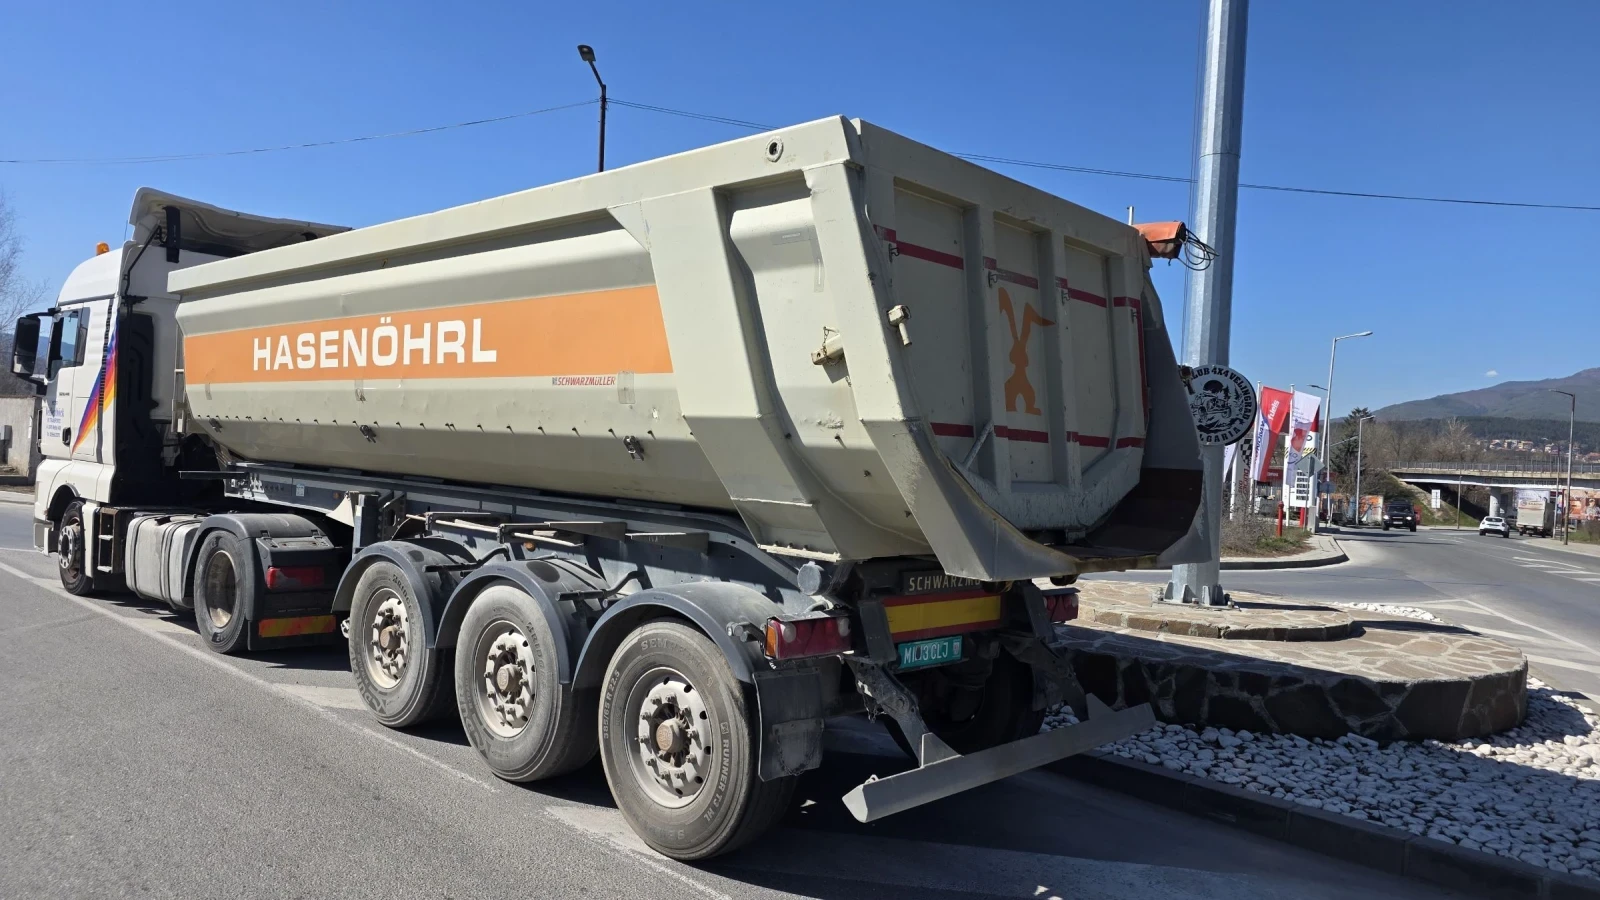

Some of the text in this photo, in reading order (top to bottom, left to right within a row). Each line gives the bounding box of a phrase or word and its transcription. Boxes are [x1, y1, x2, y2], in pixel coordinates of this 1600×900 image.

[253, 316, 497, 371] HASENÖHRL
[557, 376, 616, 386] SCHWARZMÜLLER
[1192, 367, 1210, 379] LUB
[1229, 372, 1253, 420] VELINGRAD
[1267, 399, 1280, 420] fuels
[1199, 427, 1241, 442] LGARIA
[603, 669, 621, 739] 385/65 R 22.5
[718, 739, 730, 793] RUNNER
[703, 807, 715, 823] HL
